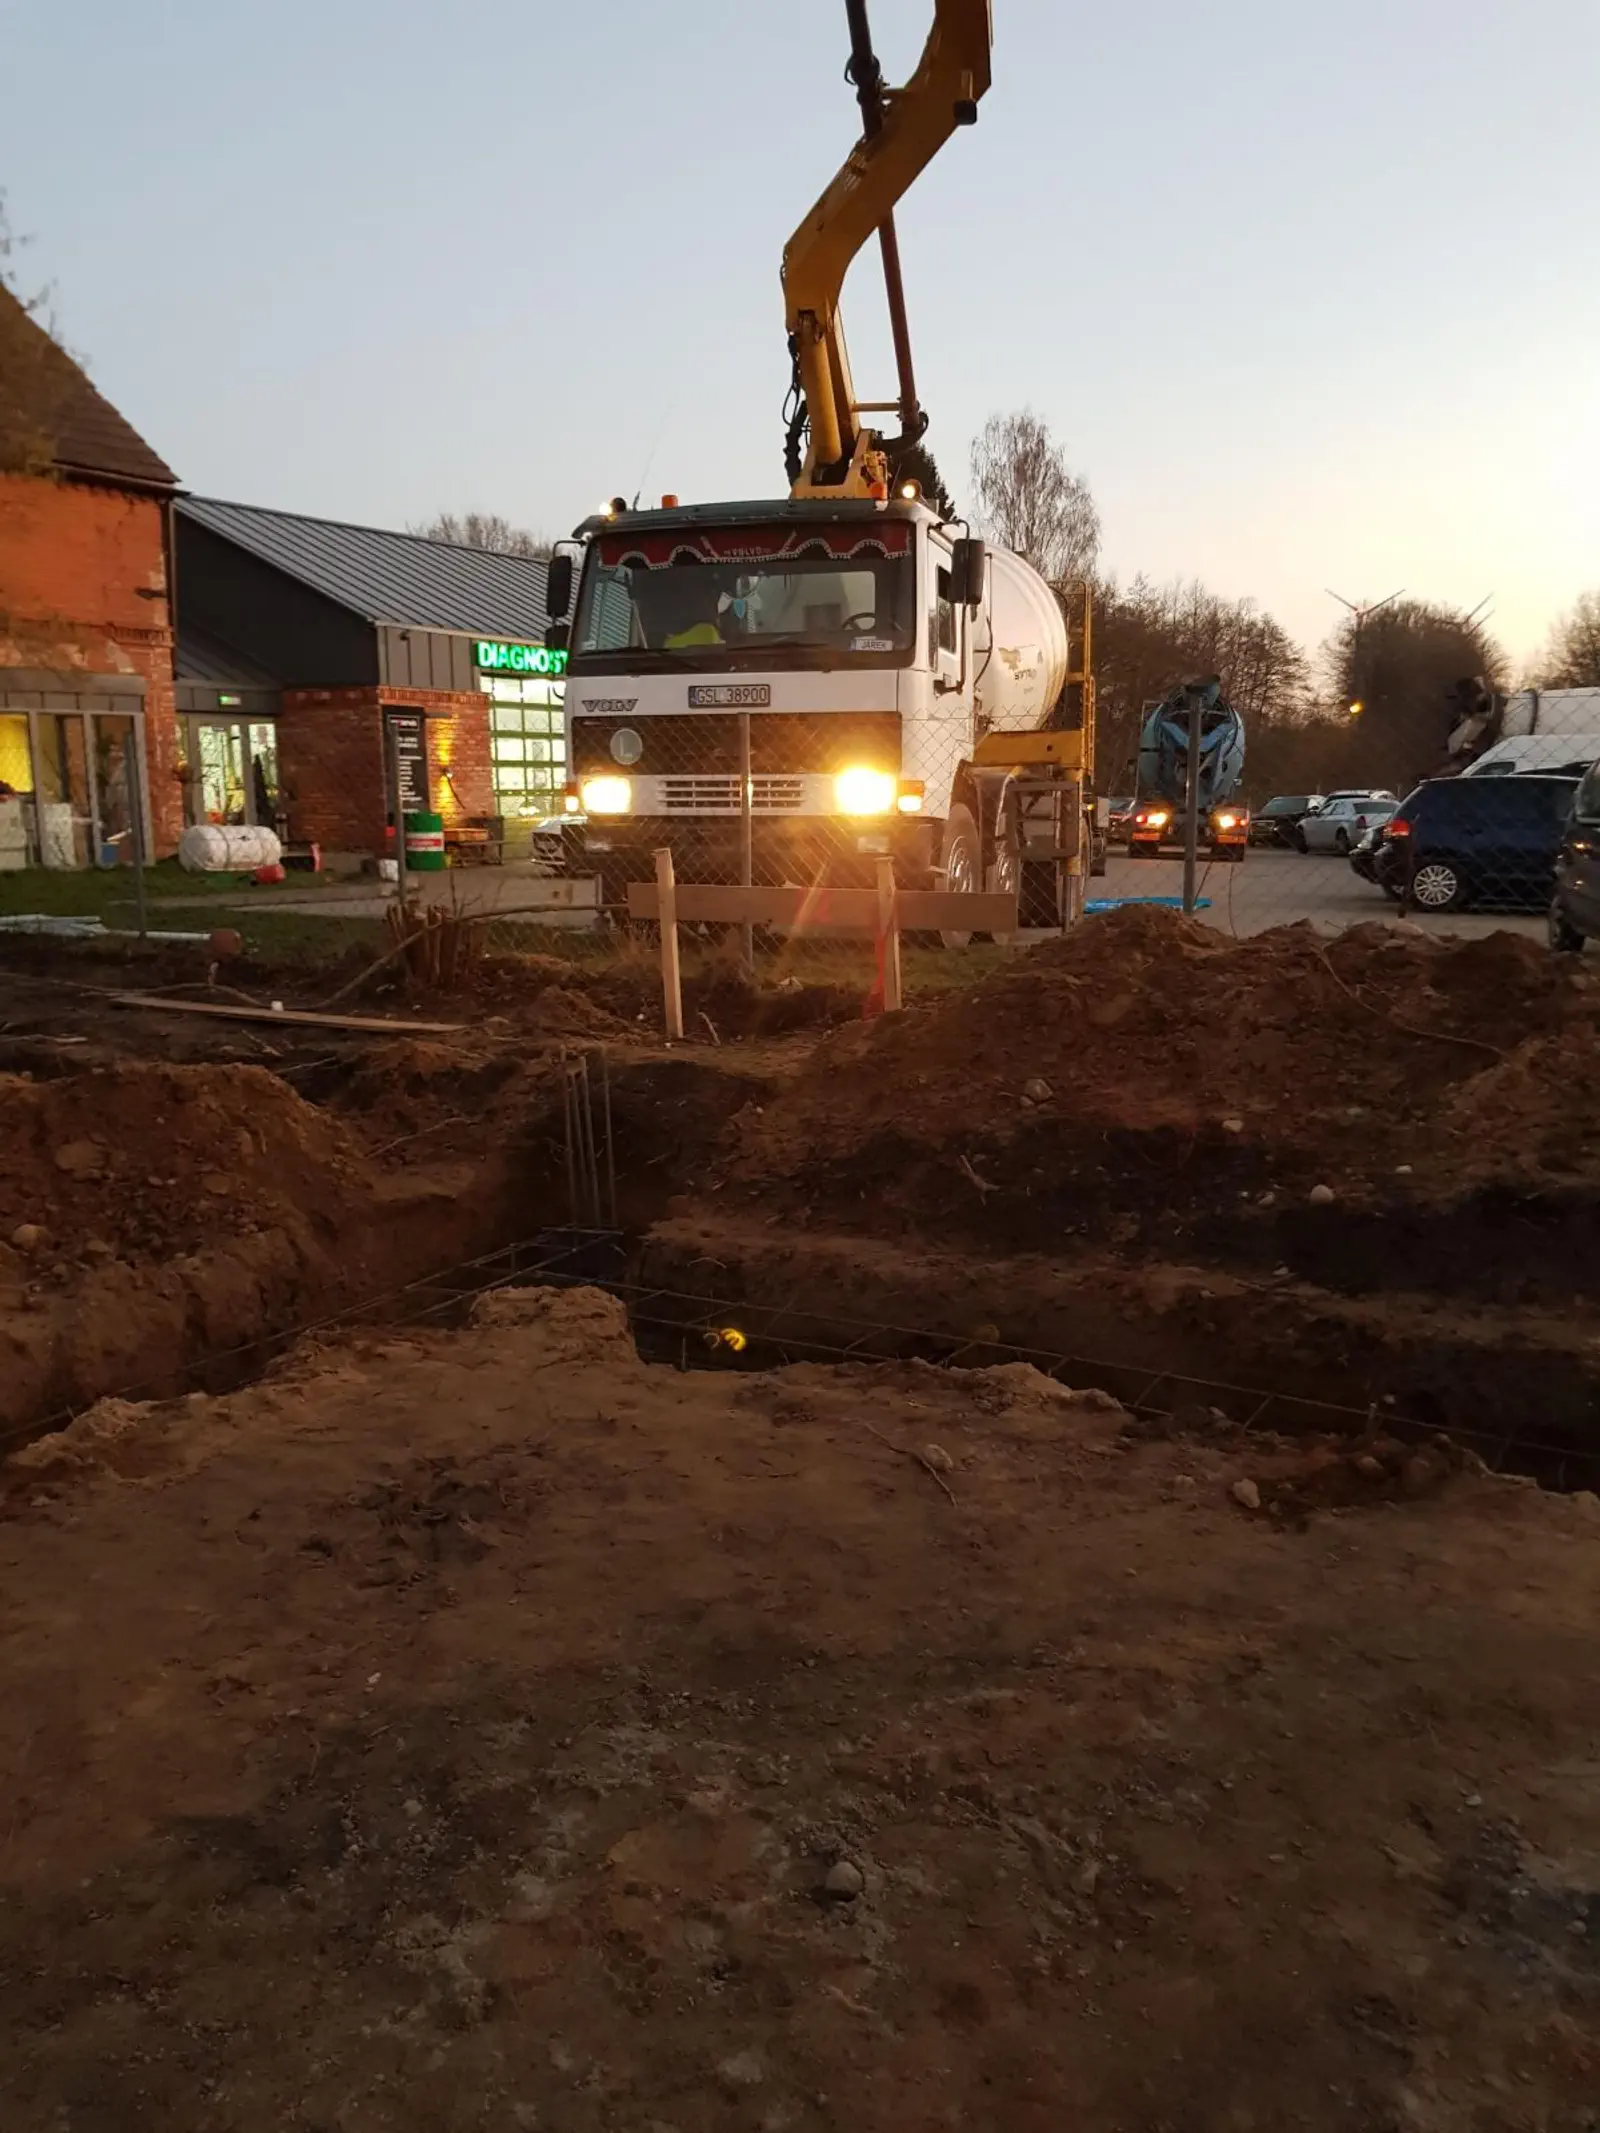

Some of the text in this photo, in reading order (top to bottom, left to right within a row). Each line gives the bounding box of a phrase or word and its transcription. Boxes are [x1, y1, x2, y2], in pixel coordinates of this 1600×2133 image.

[697, 687, 767, 704] GSL 38900
[581, 699, 639, 714] VOLV
